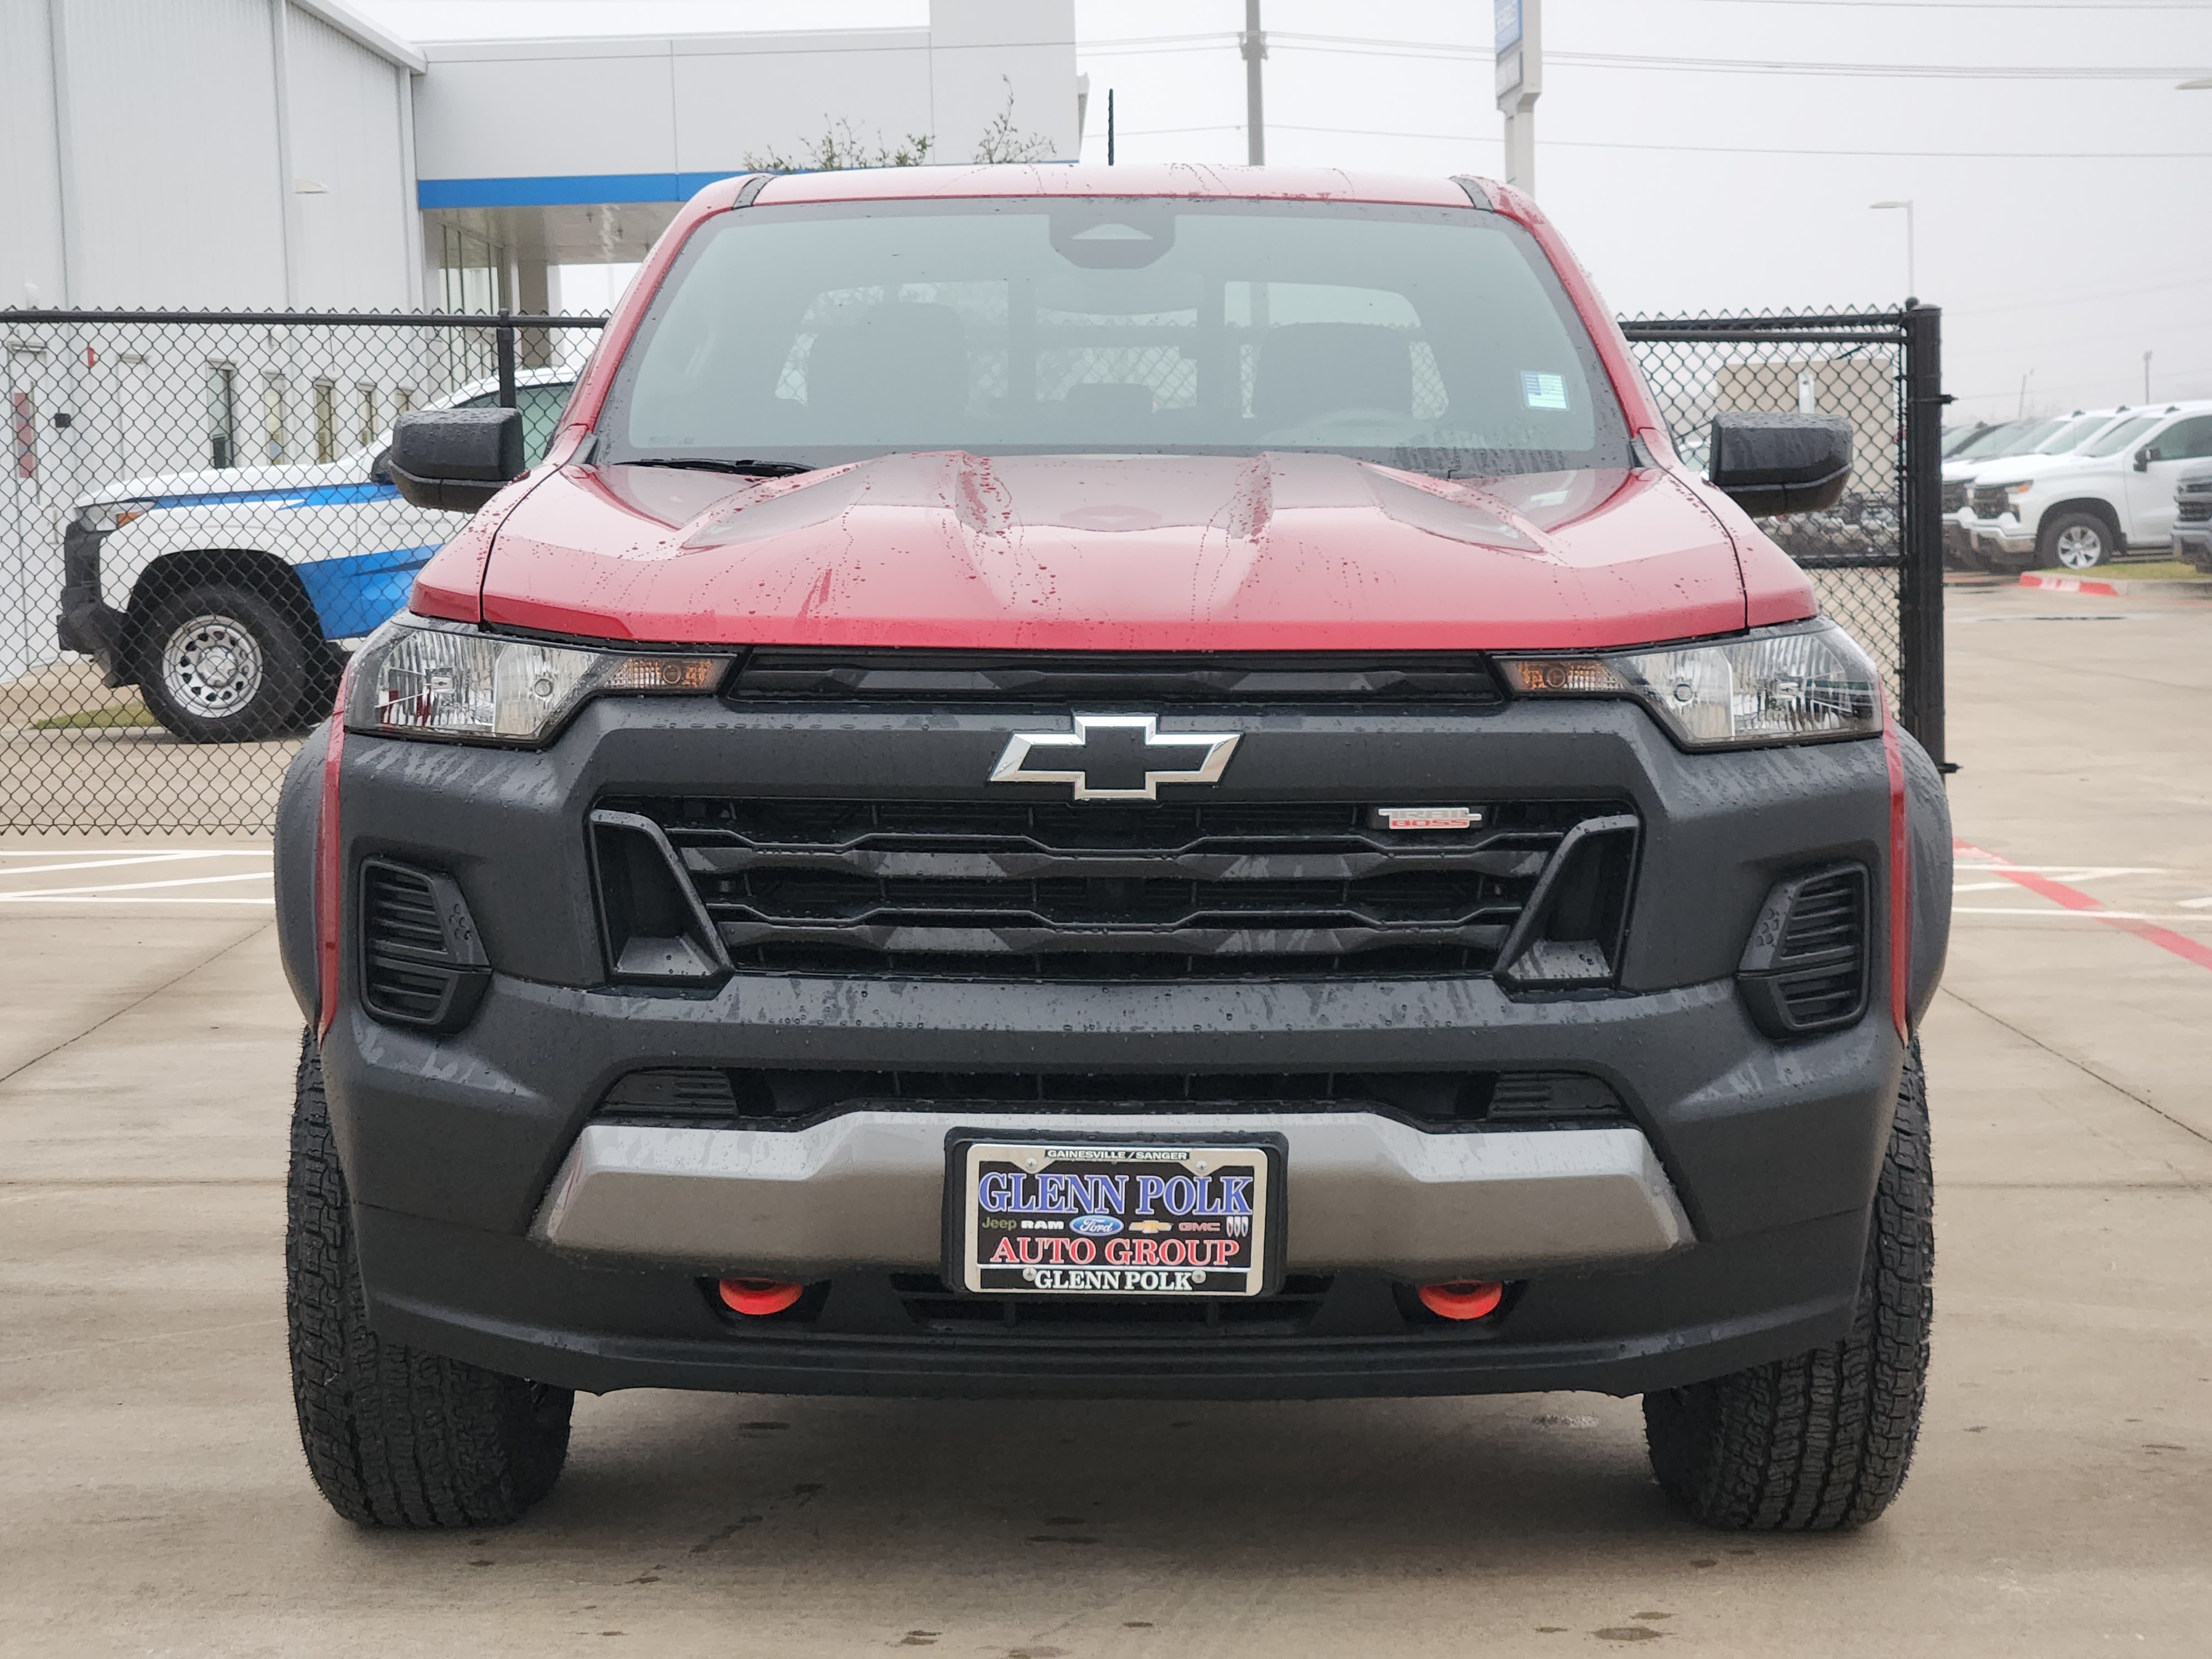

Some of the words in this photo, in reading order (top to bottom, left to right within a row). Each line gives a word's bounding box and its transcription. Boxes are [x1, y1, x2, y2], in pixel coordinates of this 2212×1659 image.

[1379, 807, 1481, 821] TRAIL
[978, 1171, 1129, 1215] GLENN
[1135, 1175, 1253, 1215] POLK
[982, 1217, 1017, 1231] Jeep
[1021, 1220, 1065, 1230] RAM
[1079, 1218, 1113, 1233] Ford
[1178, 1222, 1221, 1232] GMC
[990, 1237, 1097, 1264] AUTO
[1105, 1238, 1240, 1265] GROUP
[1034, 1270, 1121, 1290] GLENN
[1124, 1271, 1193, 1291] POLK
